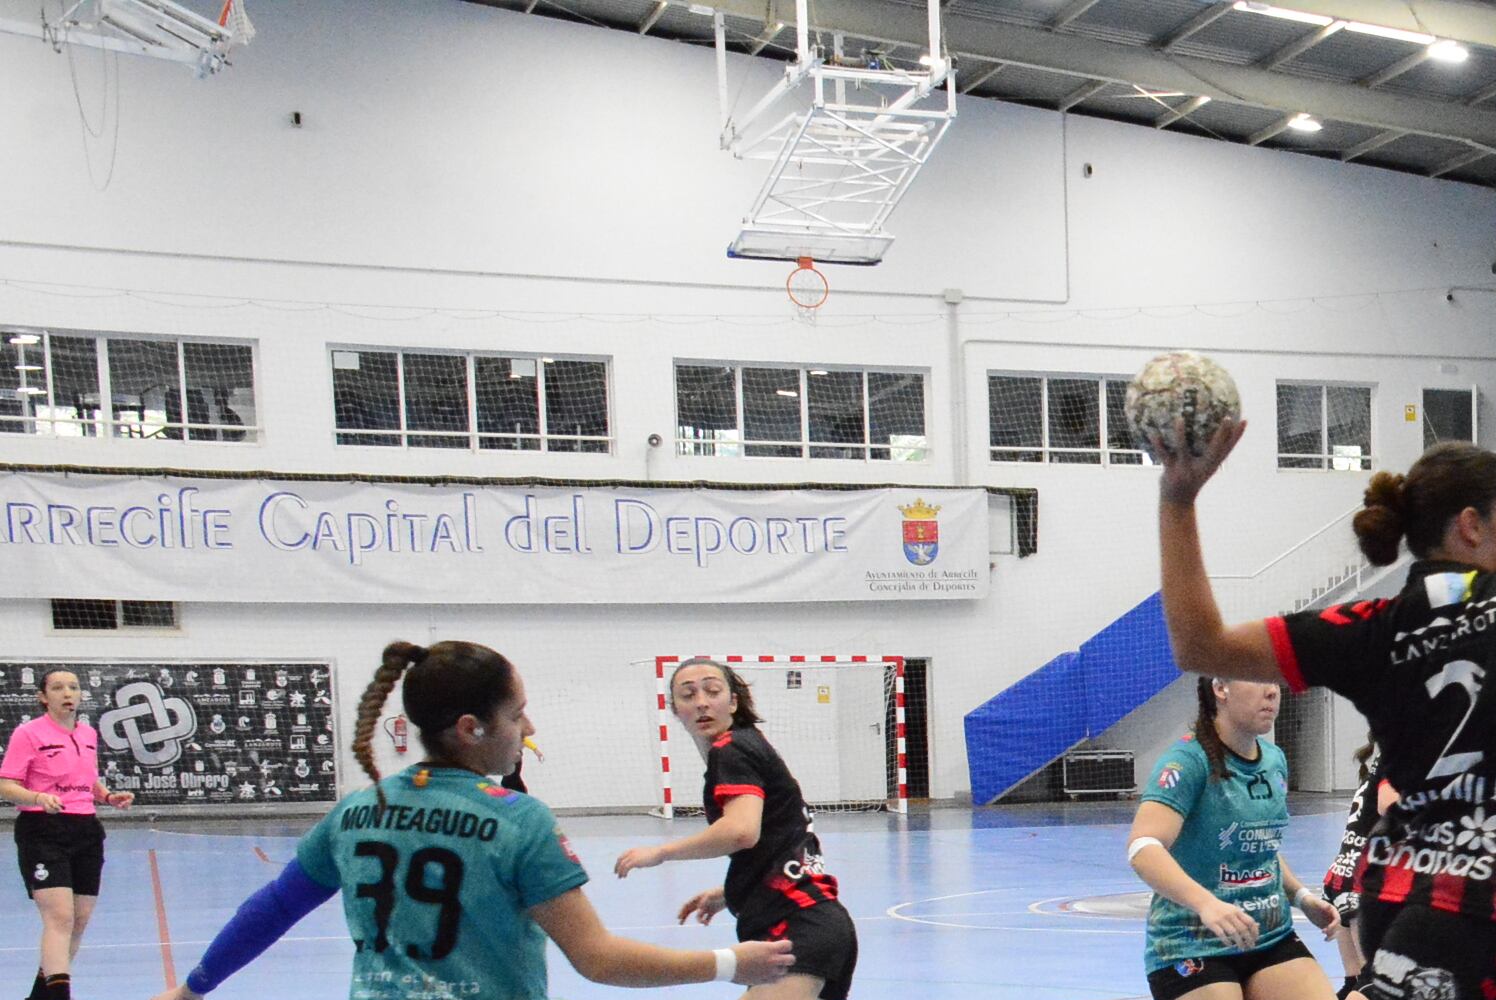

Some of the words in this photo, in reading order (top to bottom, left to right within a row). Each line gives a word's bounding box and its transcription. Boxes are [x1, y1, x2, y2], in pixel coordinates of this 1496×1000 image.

[1423, 660, 1487, 780] 2
[115, 773, 140, 789] San
[145, 771, 177, 789] José
[180, 772, 229, 789] Obrero
[341, 803, 498, 842] MONTEAGUDO
[353, 841, 465, 960] 39
